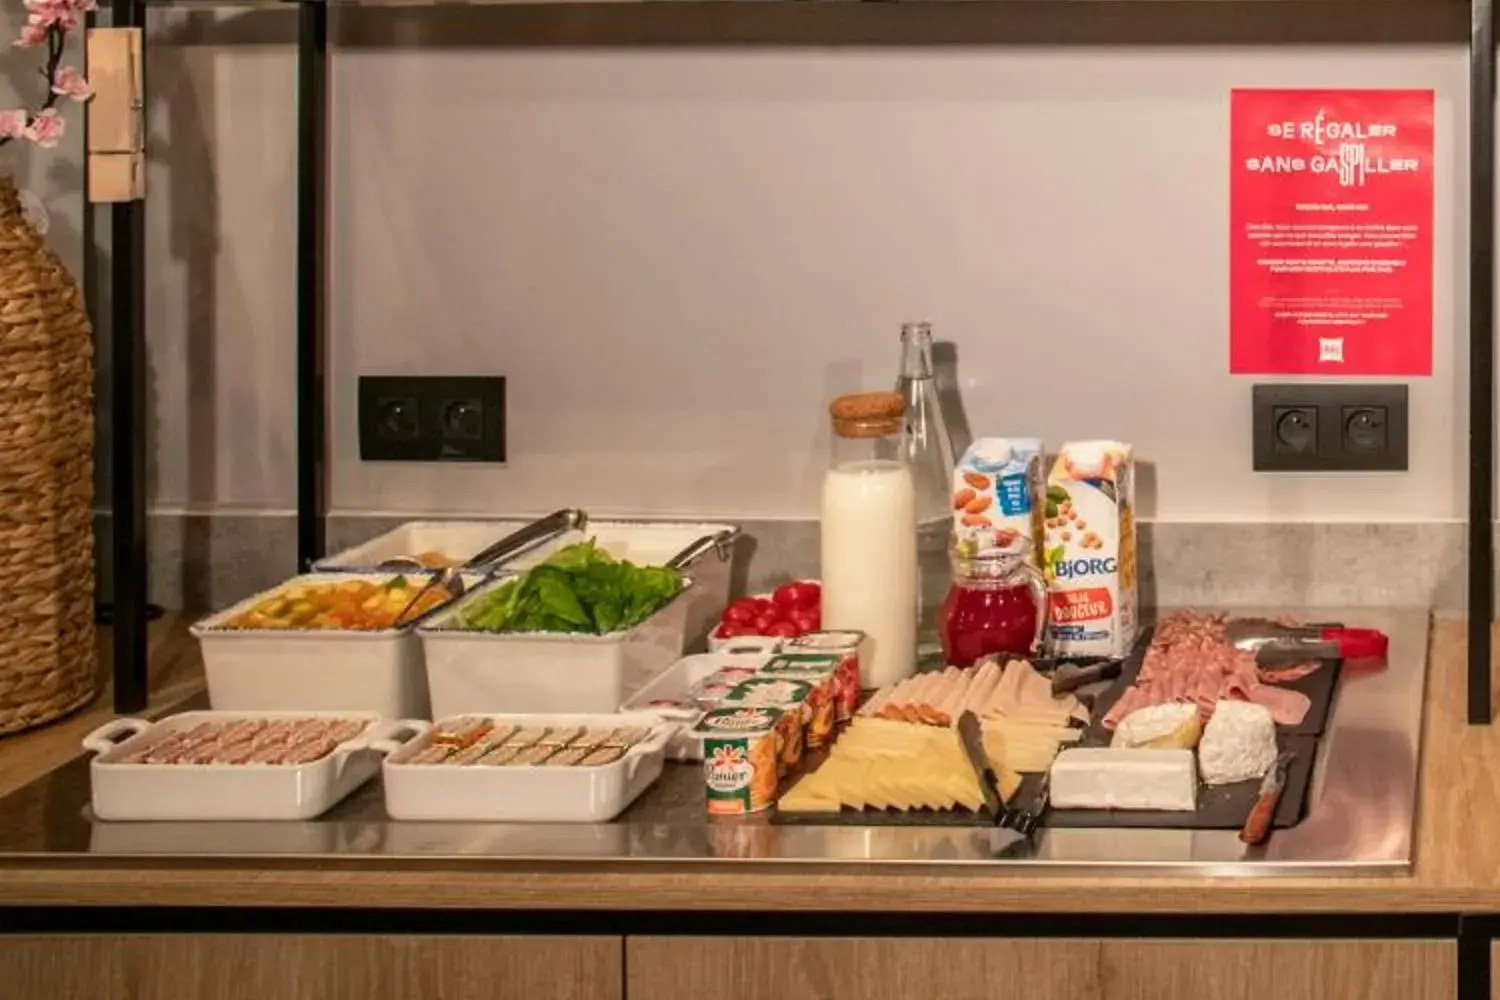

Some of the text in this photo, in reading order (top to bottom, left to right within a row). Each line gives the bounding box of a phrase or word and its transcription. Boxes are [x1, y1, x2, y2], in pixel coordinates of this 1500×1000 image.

[1267, 108, 1397, 145] SE RÉGALER
[1246, 143, 1419, 187] SANS GASPILLER
